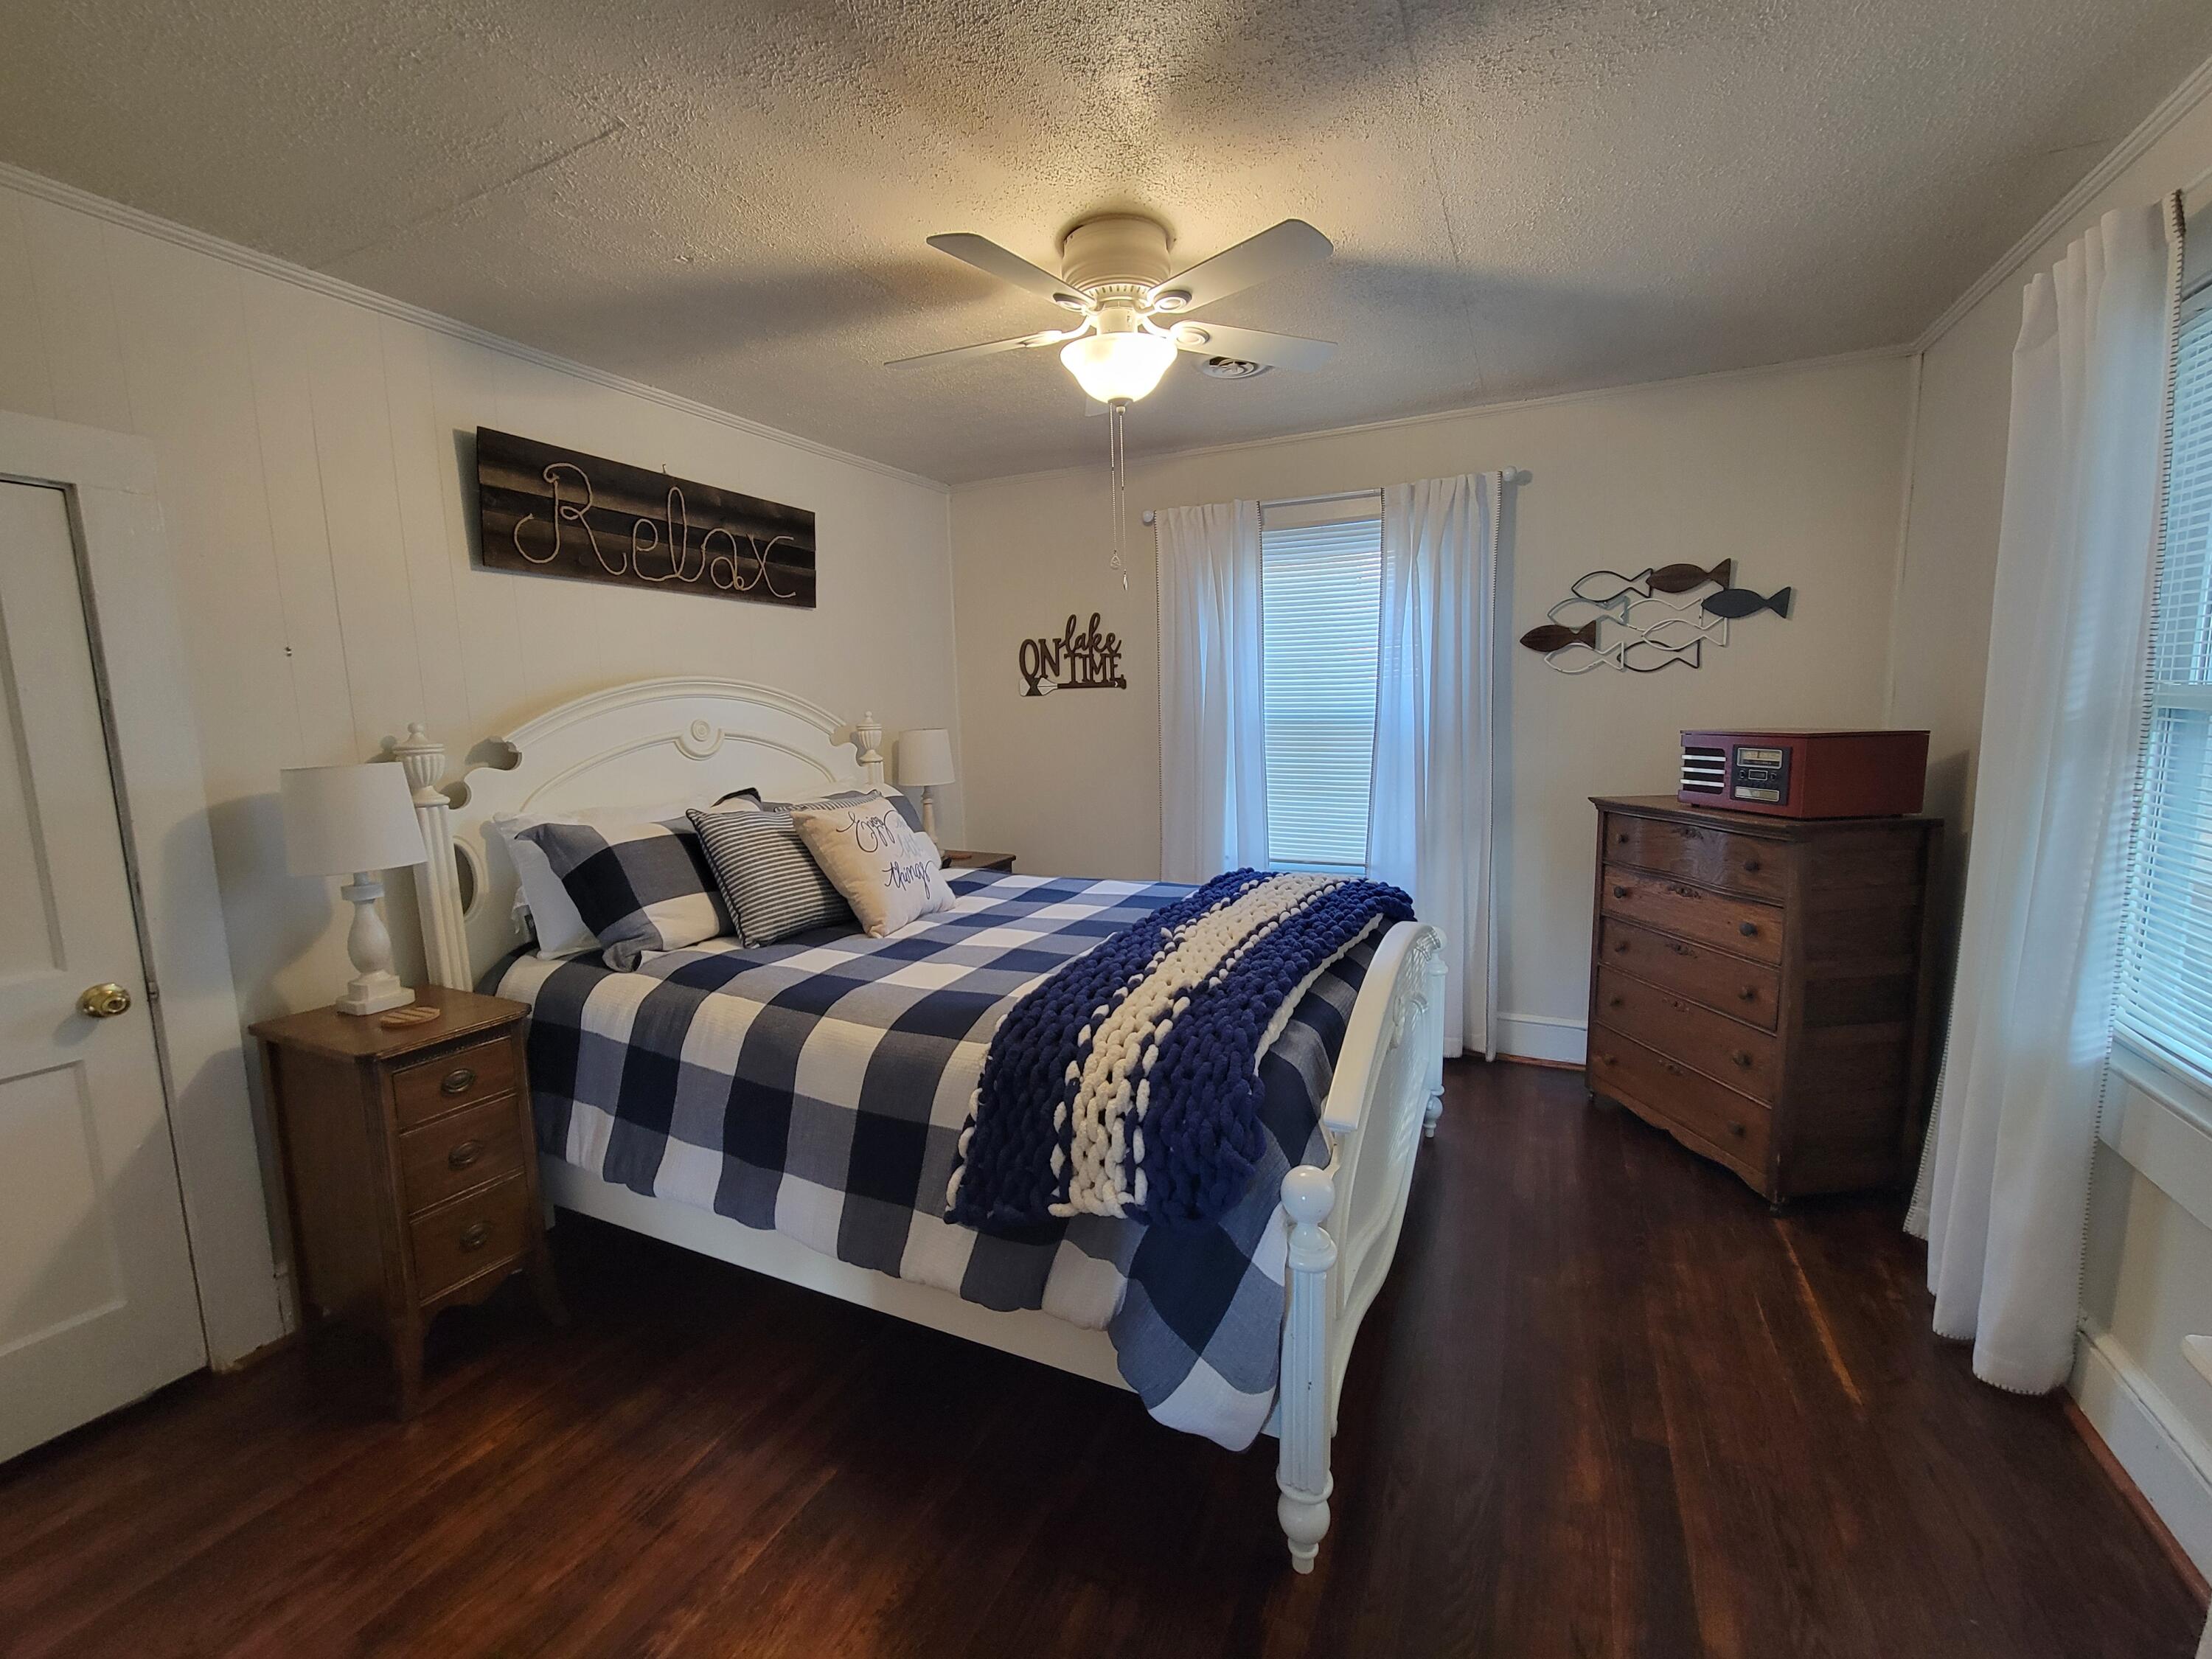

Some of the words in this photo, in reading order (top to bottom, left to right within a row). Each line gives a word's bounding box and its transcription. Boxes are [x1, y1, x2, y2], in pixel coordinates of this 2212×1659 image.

[514, 462, 796, 598] Relax
[1019, 639, 1061, 679] ON
[1059, 612, 1121, 655] lake
[1064, 653, 1124, 683] TIME
[836, 810, 897, 852] Enjoy
[882, 860, 940, 900] things
